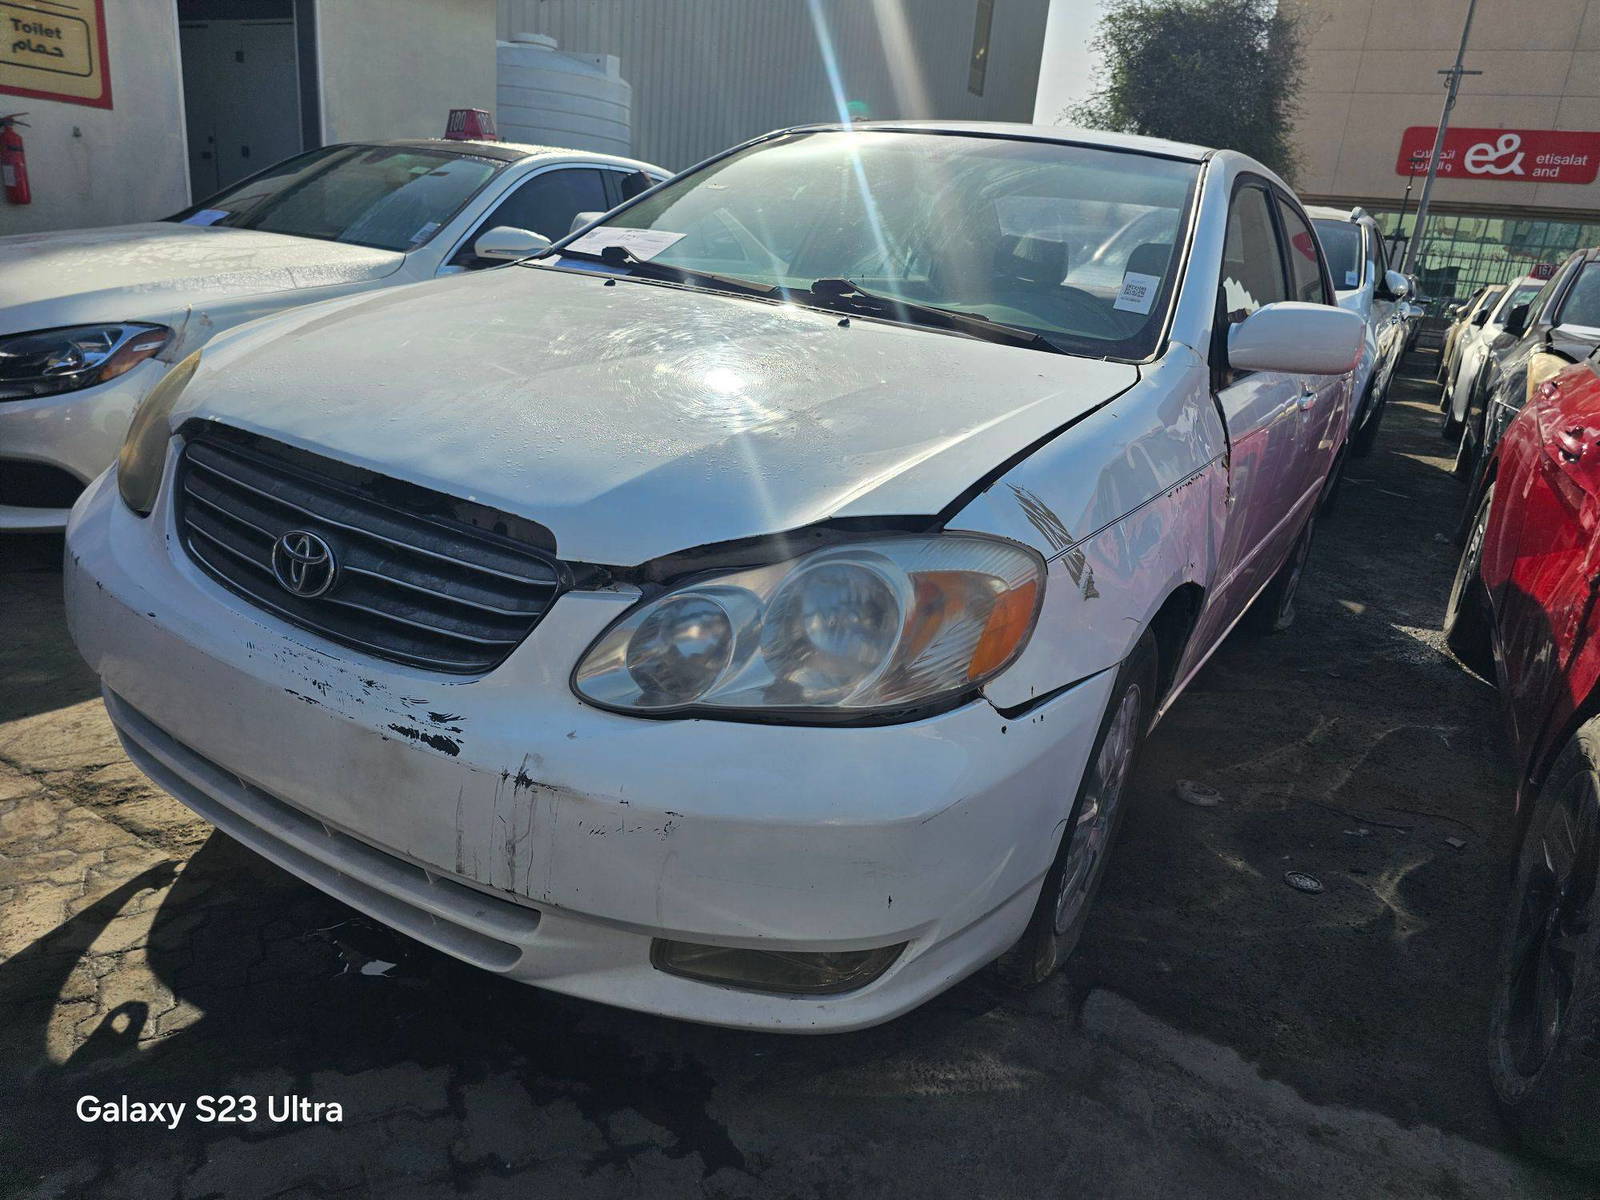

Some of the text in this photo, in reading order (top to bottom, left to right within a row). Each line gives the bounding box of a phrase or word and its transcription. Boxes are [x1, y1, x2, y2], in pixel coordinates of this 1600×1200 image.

[10, 18, 62, 39] Toilet
[12, 39, 65, 57] حمام
[1412, 149, 1456, 159] اتصلات
[1464, 133, 1525, 175] e&
[1535, 153, 1589, 166] etisalat
[1532, 167, 1560, 178] and
